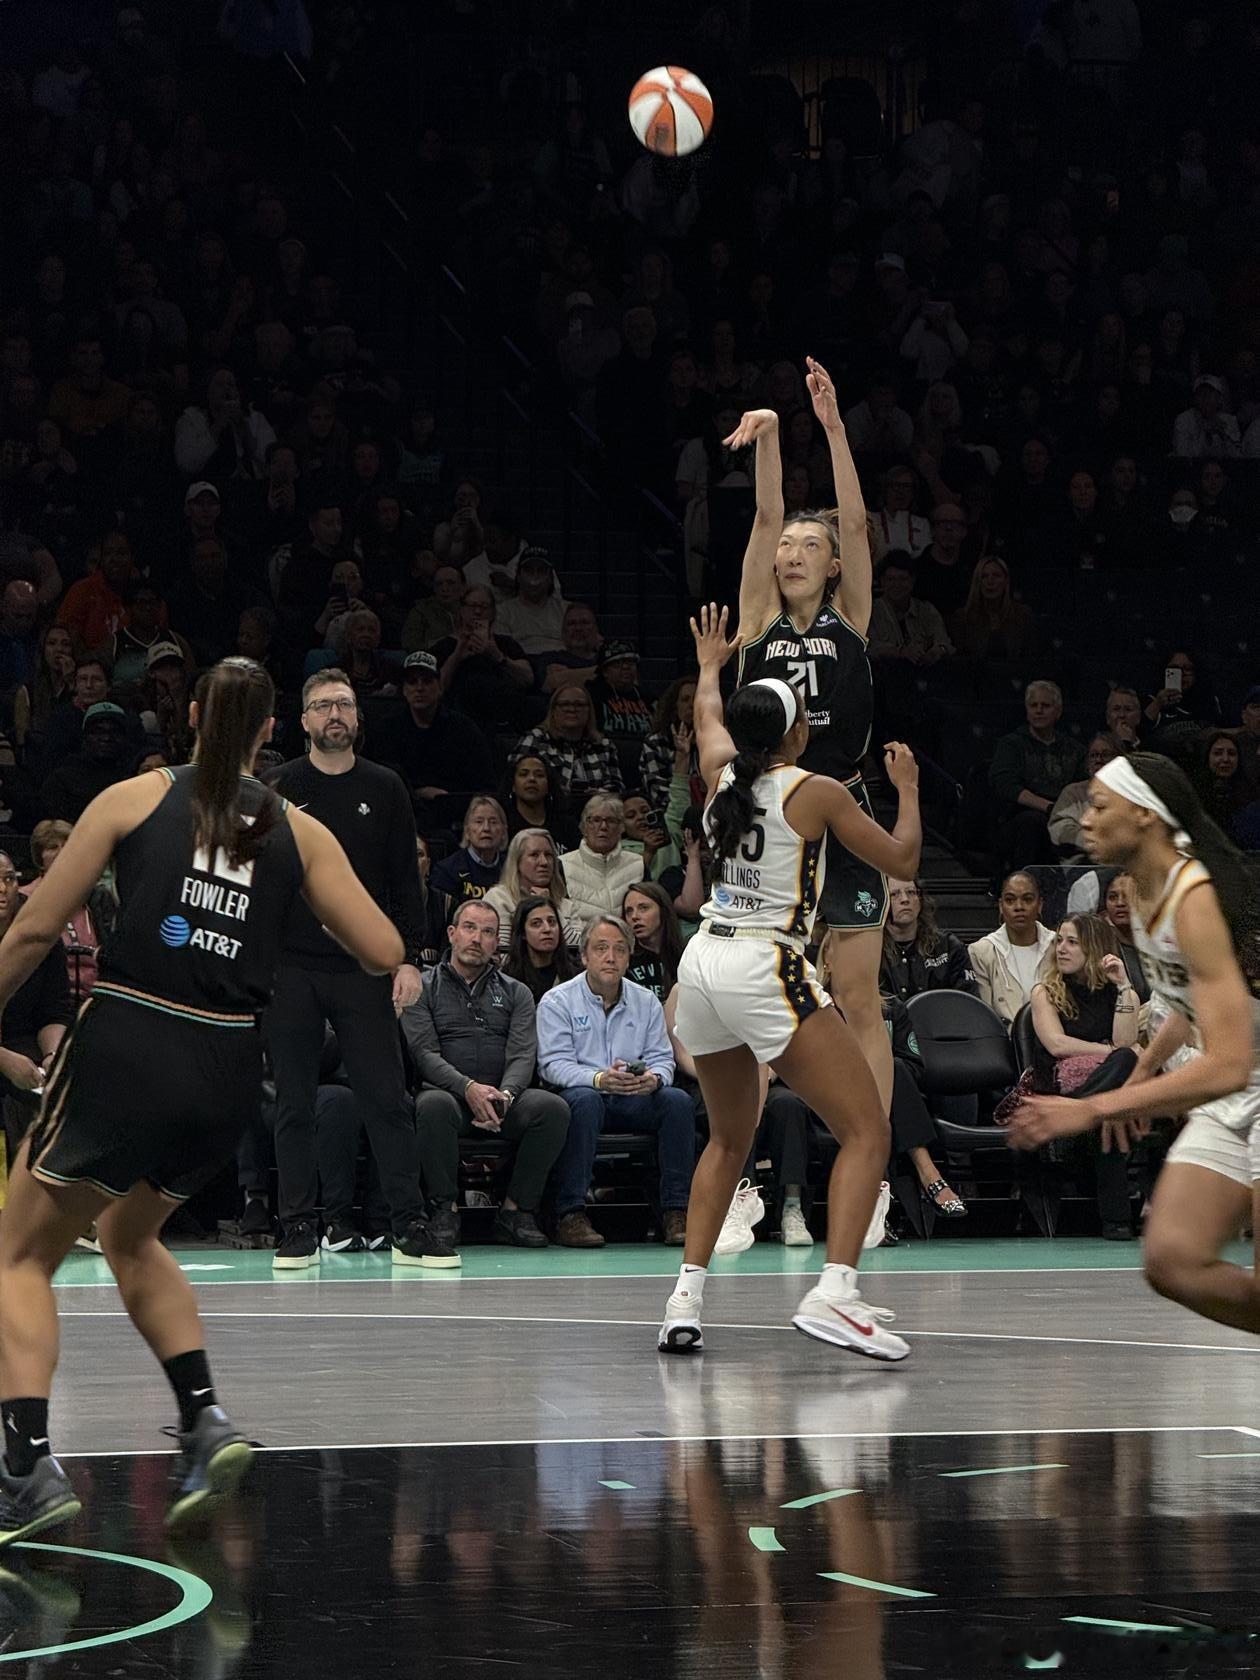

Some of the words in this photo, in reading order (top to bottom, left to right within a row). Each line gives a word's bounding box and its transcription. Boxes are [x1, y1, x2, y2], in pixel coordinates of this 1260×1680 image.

[764, 639, 801, 661] NEW
[801, 637, 838, 662] YORK
[787, 660, 819, 697] 21
[808, 716, 830, 726] utual
[180, 876, 250, 922] FOWLER
[729, 895, 765, 910] AT&T
[189, 928, 243, 960] AT&T
